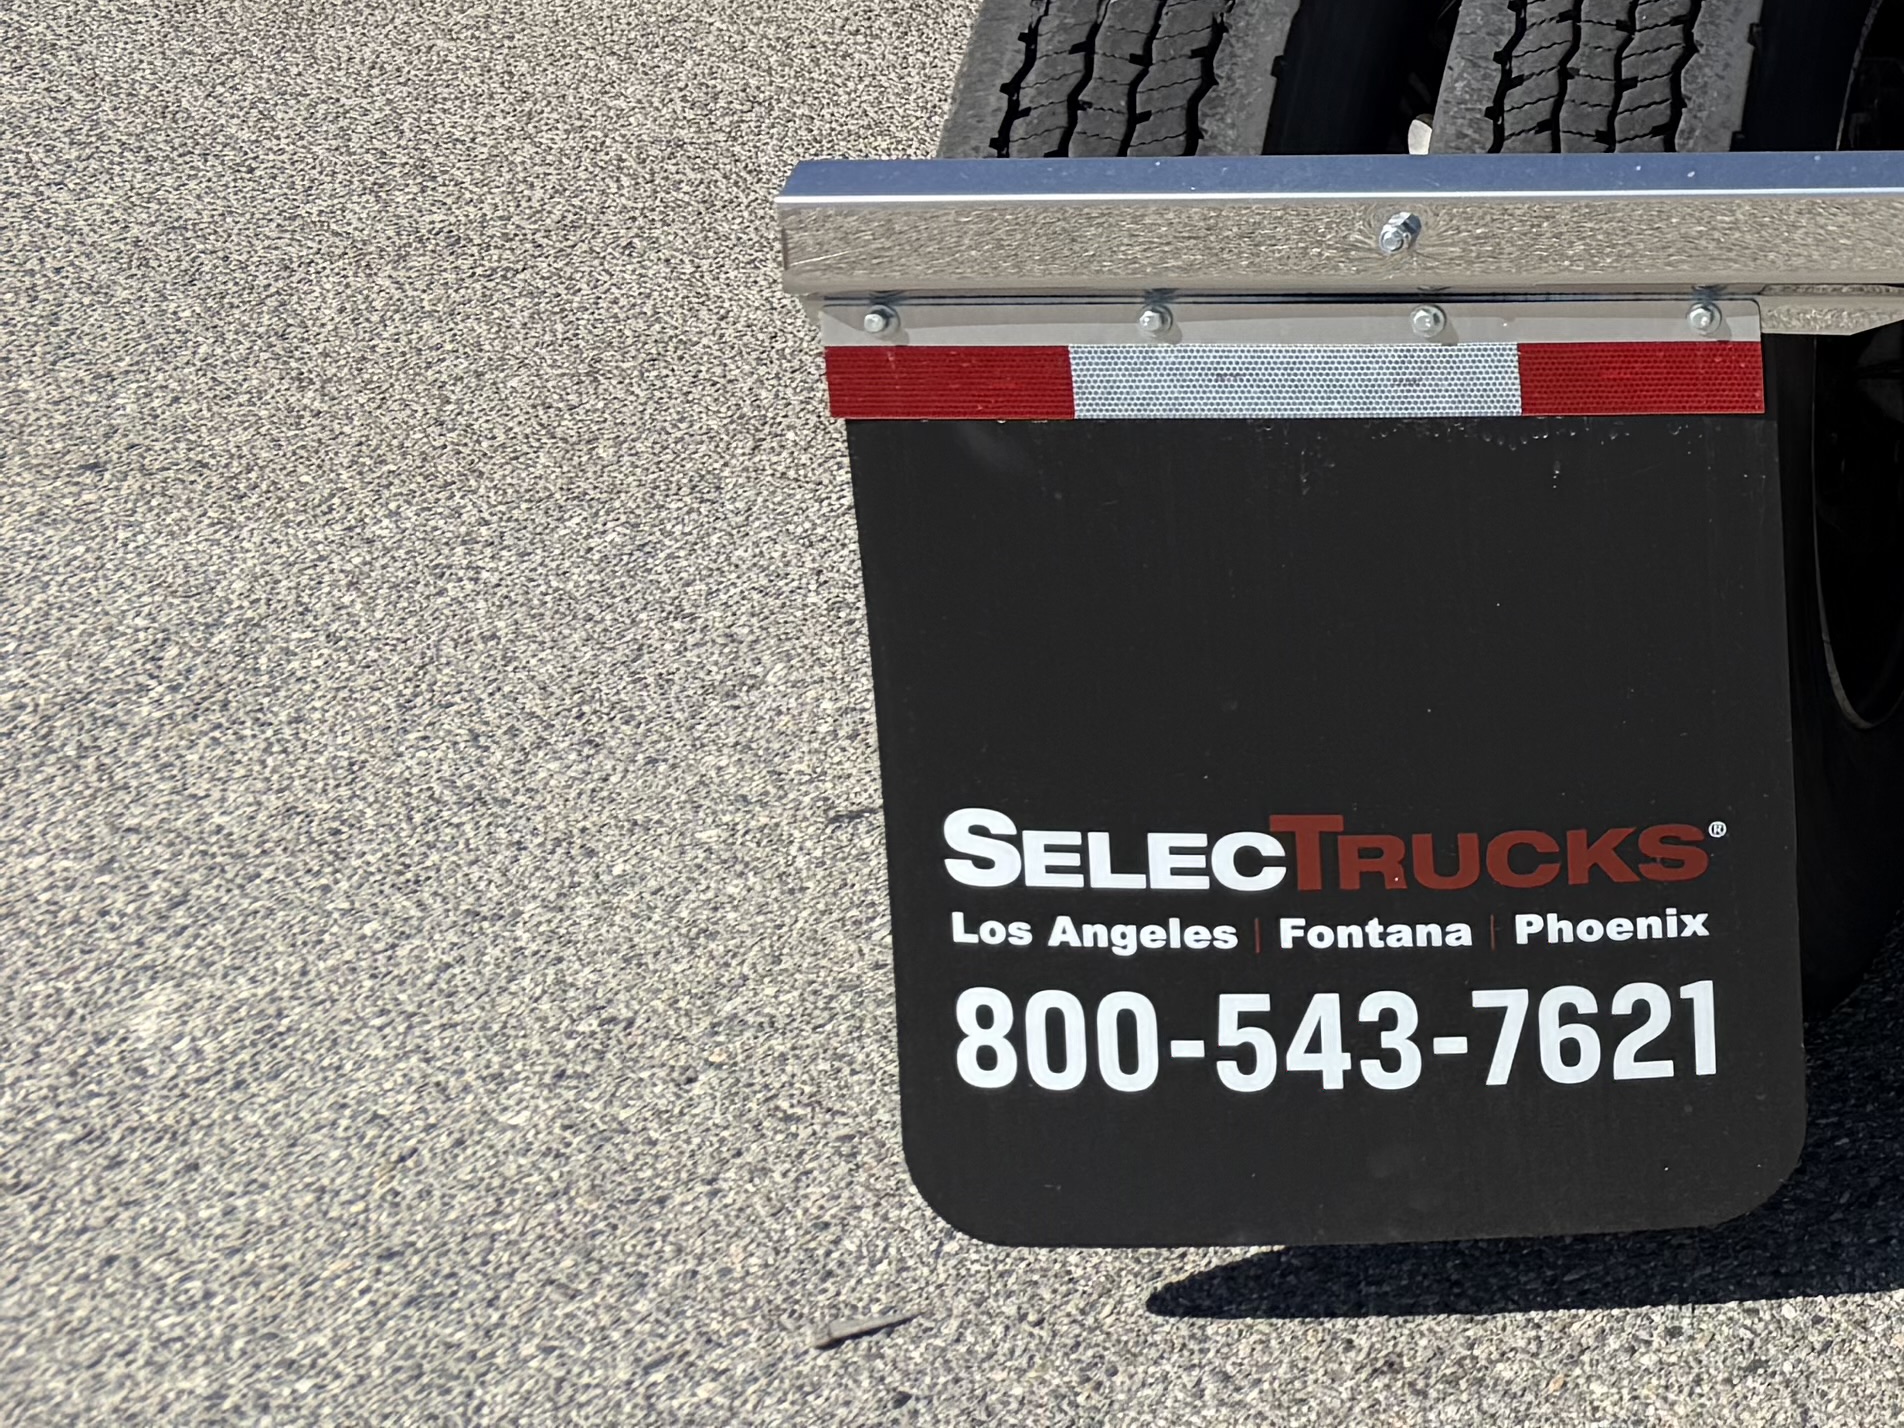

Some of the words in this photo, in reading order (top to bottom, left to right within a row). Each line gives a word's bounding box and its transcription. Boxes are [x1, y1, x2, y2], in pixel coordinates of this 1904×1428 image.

[951, 912, 1033, 946] Los
[1047, 916, 1239, 957] Angeles
[1279, 918, 1473, 949] Fontana
[1514, 907, 1710, 945] Phoenix
[955, 980, 1717, 1093] 800-543-7621
